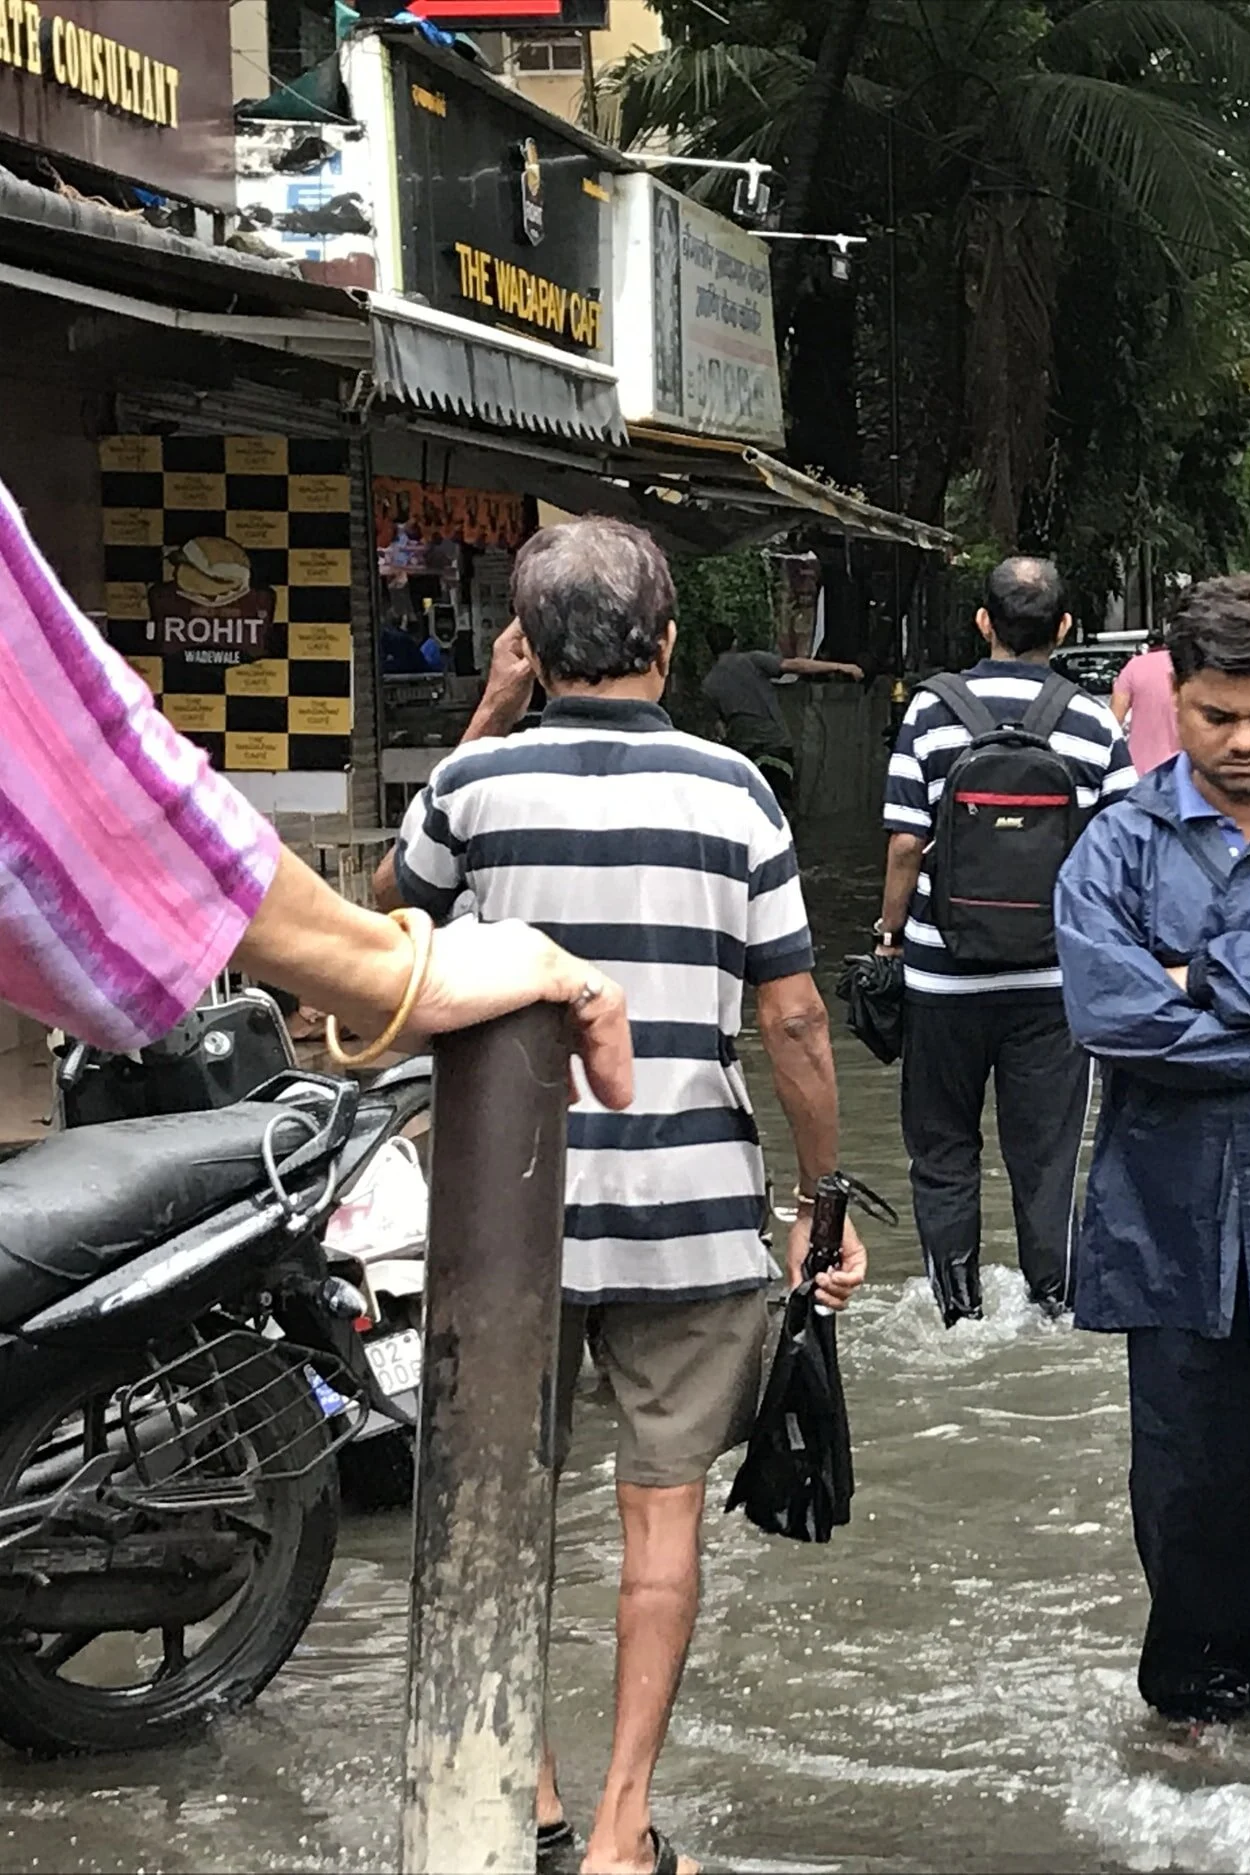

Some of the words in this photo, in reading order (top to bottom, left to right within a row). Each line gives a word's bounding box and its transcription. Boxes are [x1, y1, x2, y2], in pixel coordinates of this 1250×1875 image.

[52, 16, 179, 129] CONSULTANT
[455, 242, 494, 306] THE
[494, 257, 567, 335] WADAPAV
[164, 617, 264, 644] ROHIT
[184, 650, 240, 664] WADEWALE
[370, 1341, 402, 1368] 02
